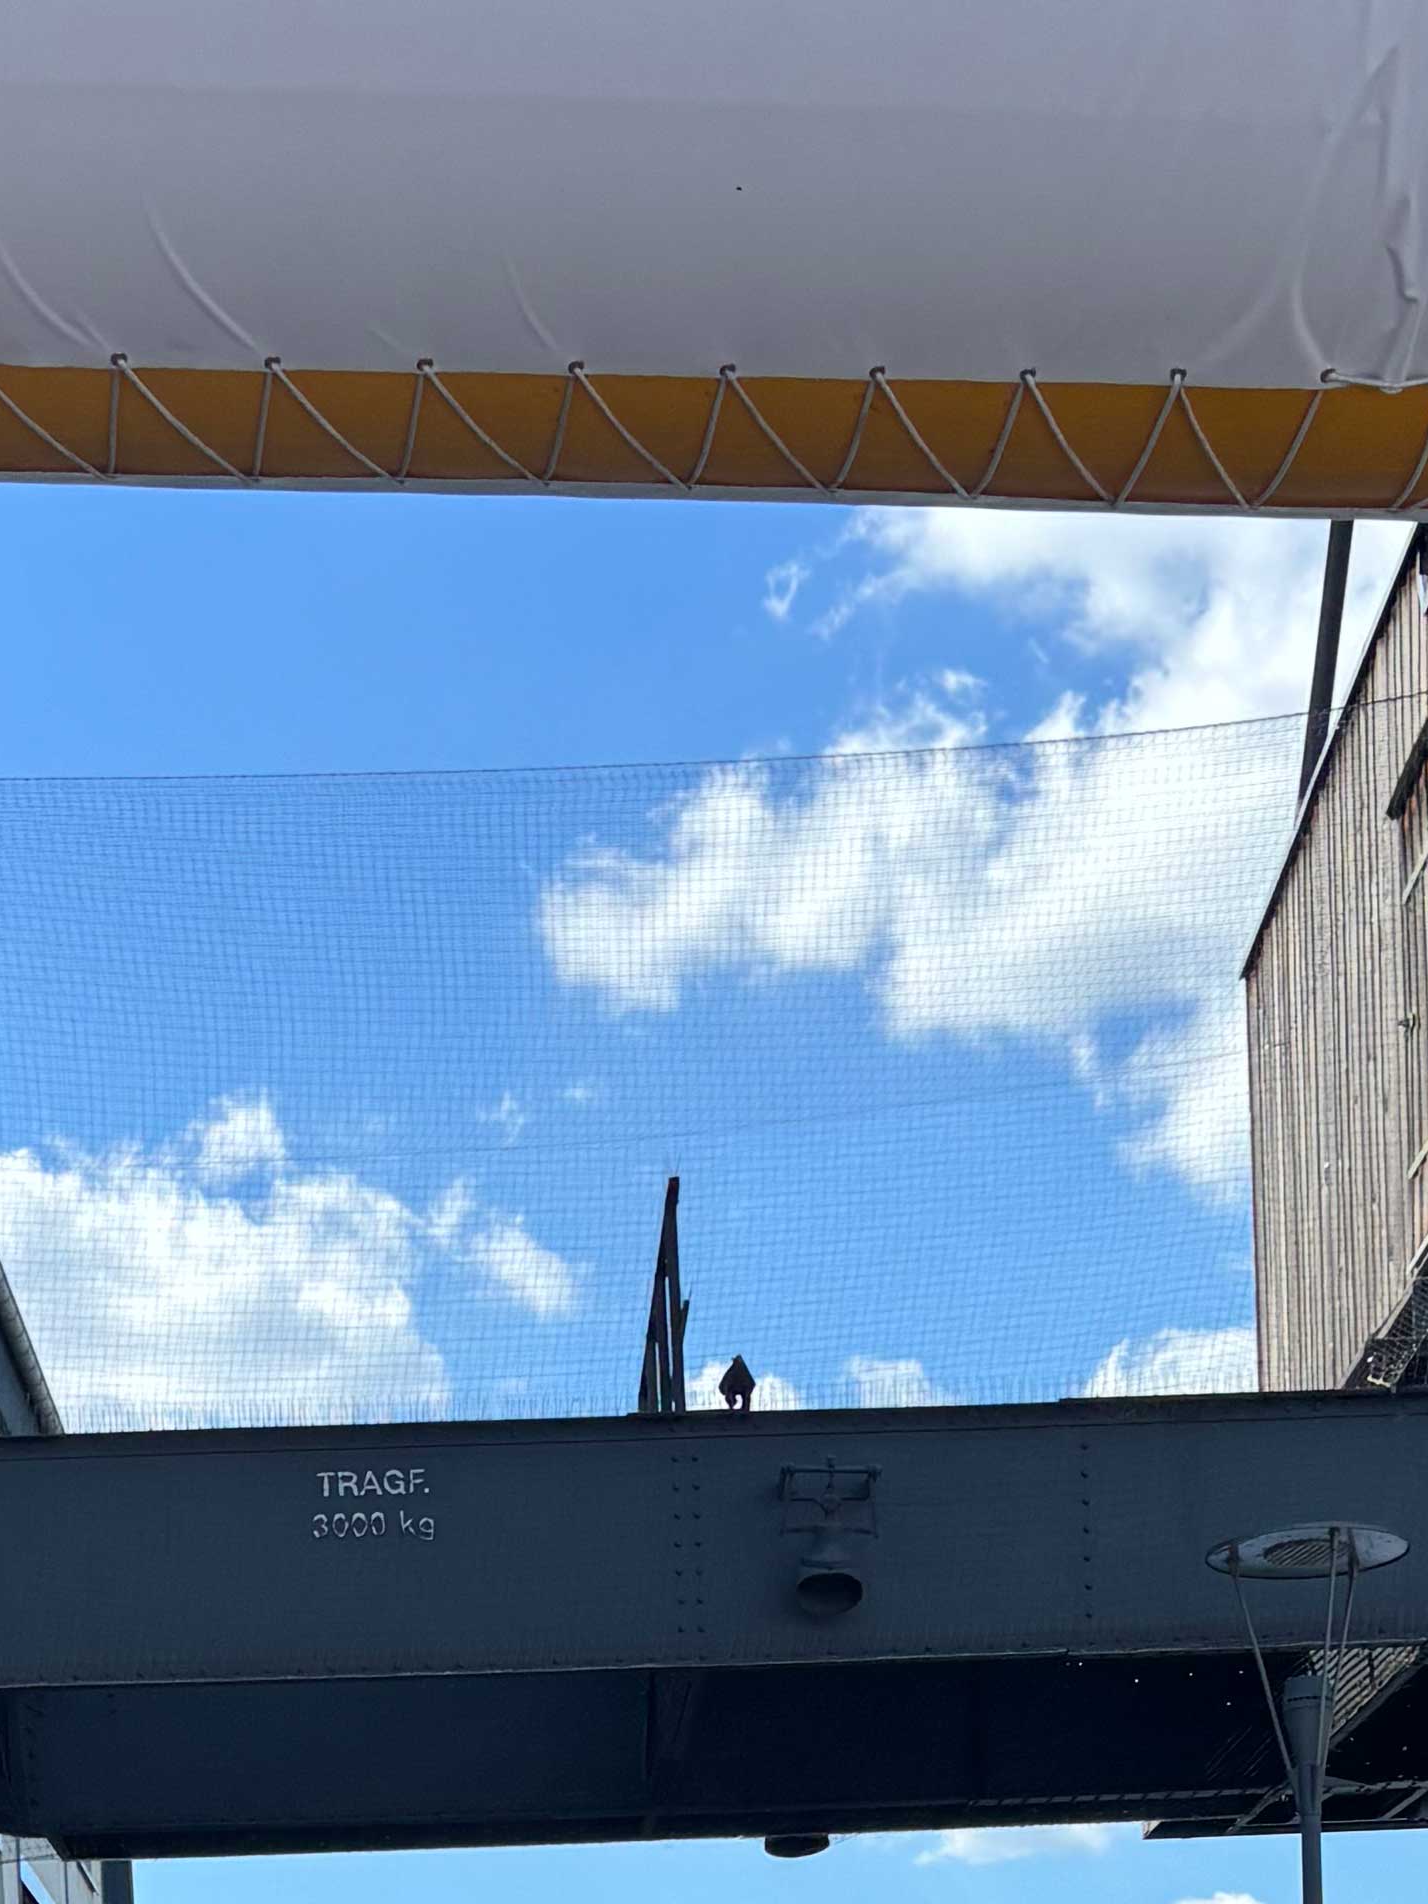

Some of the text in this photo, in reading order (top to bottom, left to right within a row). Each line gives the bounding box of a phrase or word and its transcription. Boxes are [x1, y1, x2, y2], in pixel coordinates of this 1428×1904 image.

[316, 1469, 430, 1497] TRAGF.
[313, 1510, 434, 1541] 3000 kg
